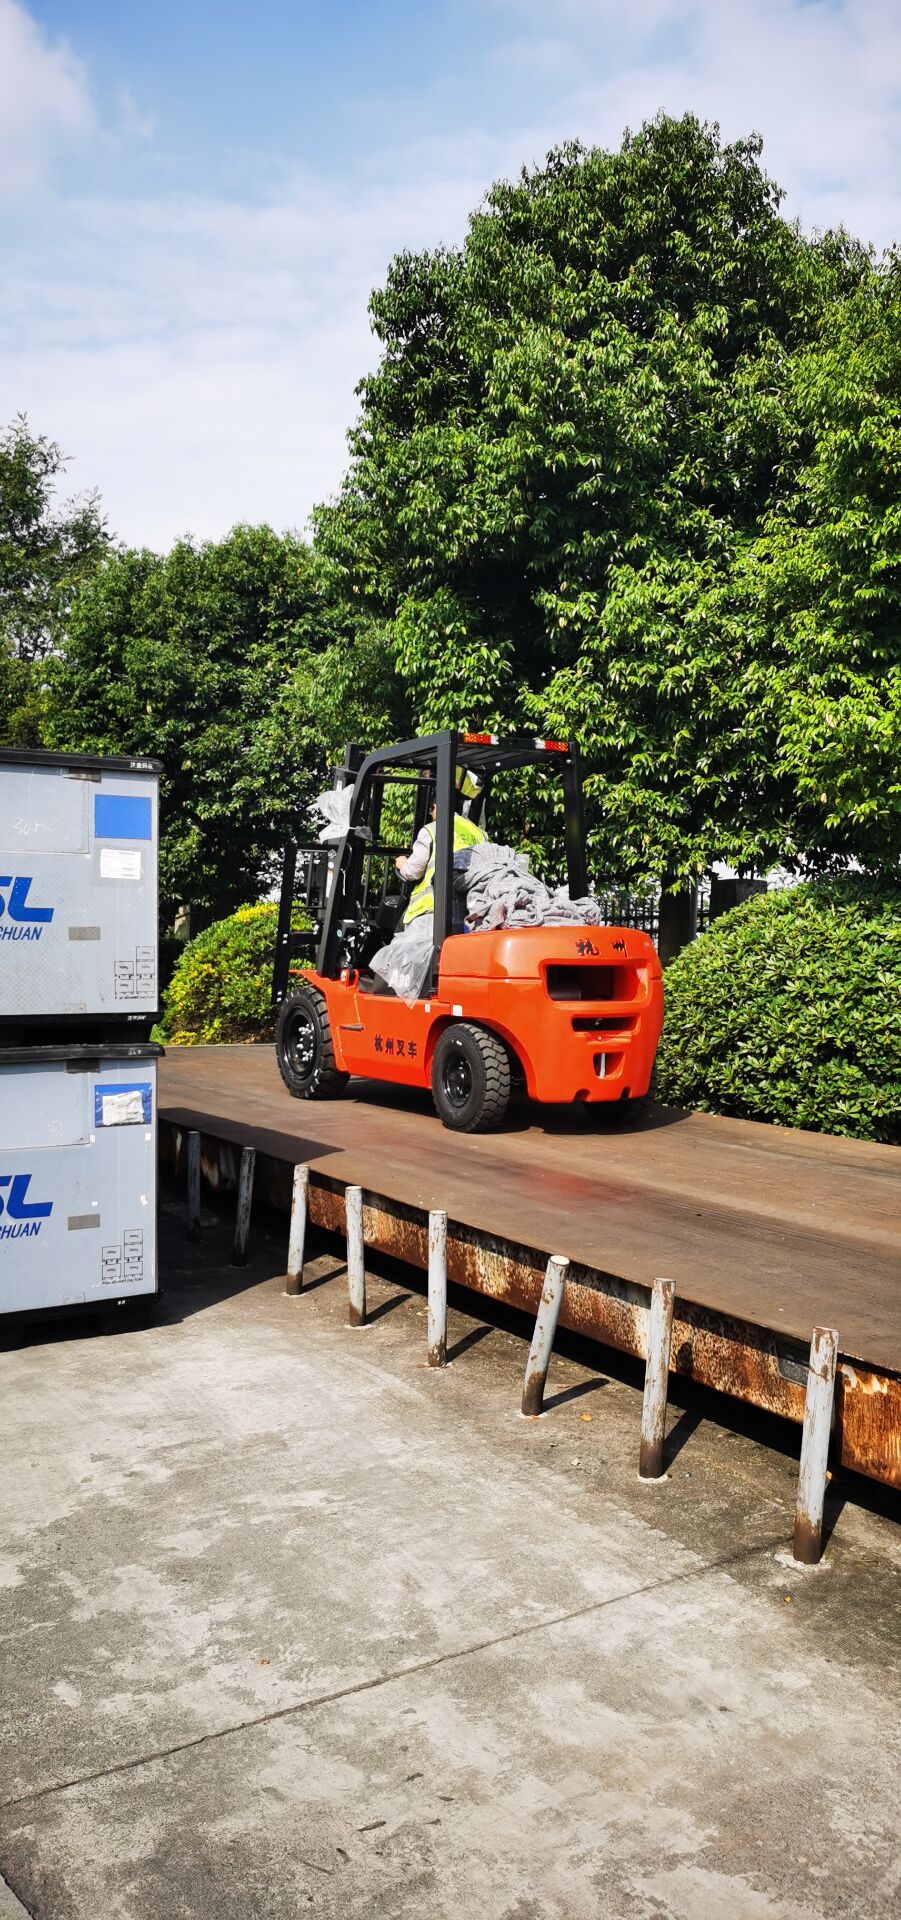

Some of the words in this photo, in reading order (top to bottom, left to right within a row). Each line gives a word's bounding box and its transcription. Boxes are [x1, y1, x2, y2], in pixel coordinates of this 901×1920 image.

[375, 1033, 417, 1059] 杭州叉车
[0, 1221, 41, 1240] HUAN
